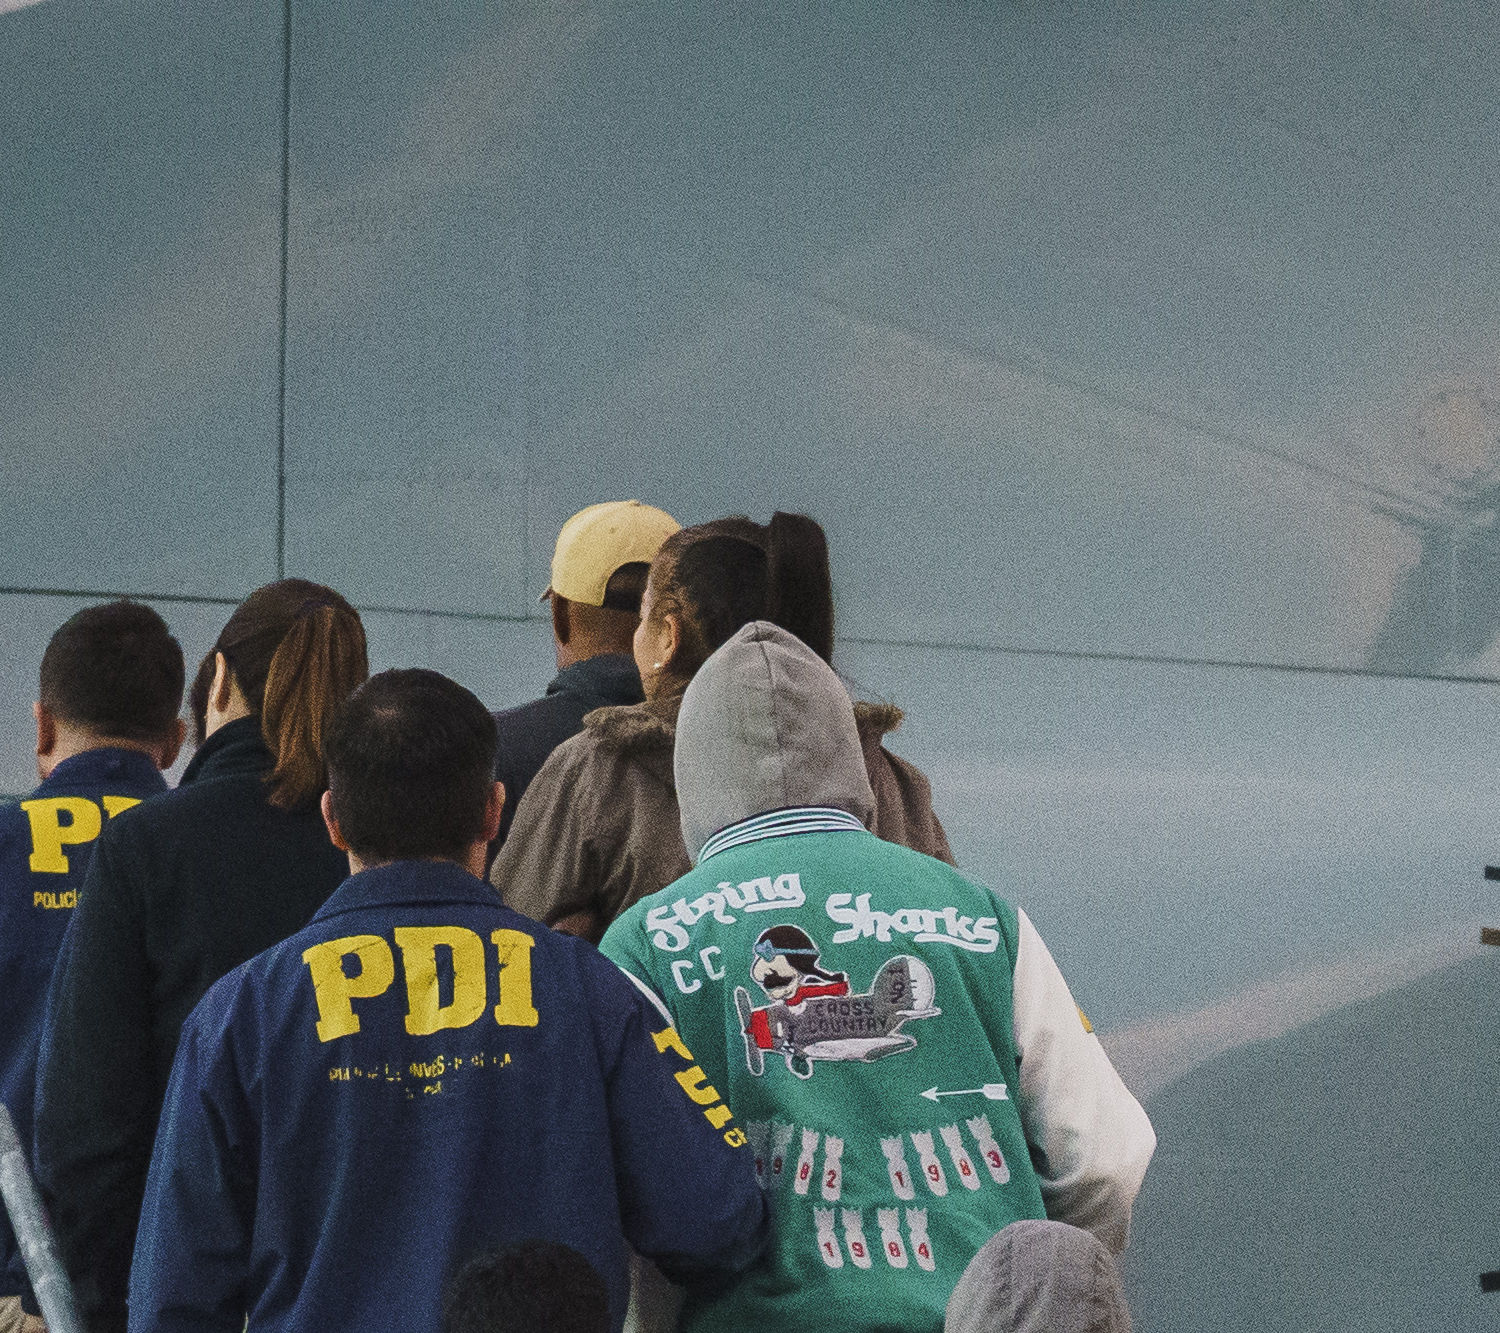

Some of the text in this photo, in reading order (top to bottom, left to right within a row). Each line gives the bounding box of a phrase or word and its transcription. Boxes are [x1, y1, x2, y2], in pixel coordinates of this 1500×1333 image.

[33, 888, 82, 910] POLICÍ
[826, 892, 1000, 953] Sharks
[302, 926, 539, 1043] PDI
[671, 945, 726, 994] CC
[809, 1016, 889, 1035] COUNTRY
[815, 1001, 875, 1018] CROSS
